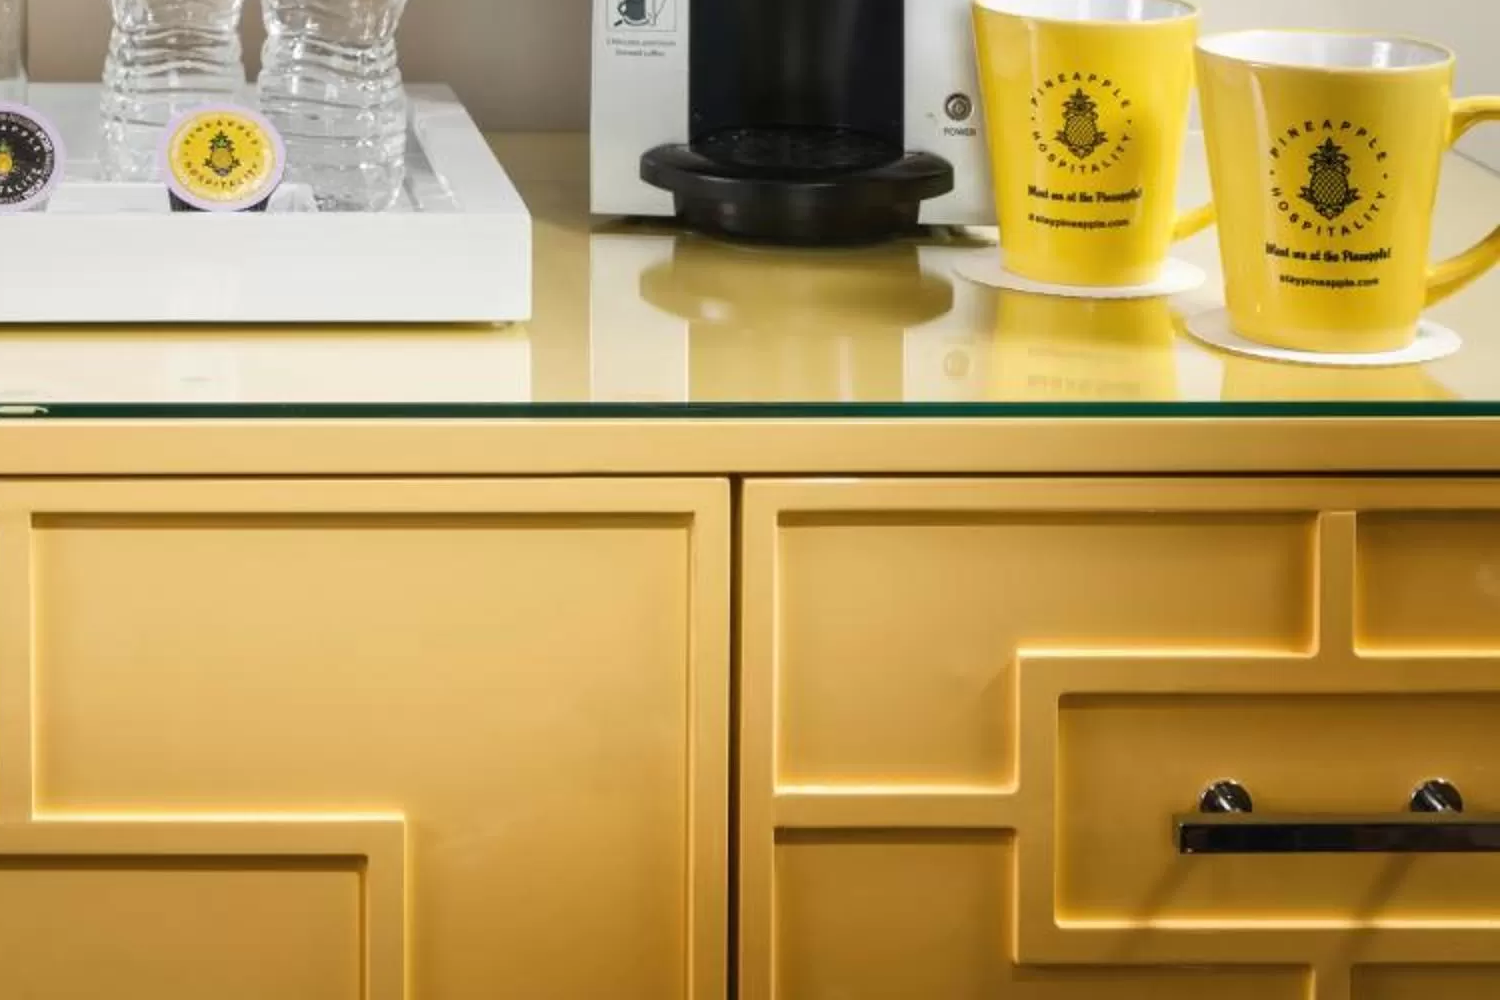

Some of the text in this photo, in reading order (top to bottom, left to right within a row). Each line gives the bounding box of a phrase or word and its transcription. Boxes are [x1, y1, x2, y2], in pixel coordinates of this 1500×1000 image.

[1030, 71, 1131, 109] PINEAPPLE
[1031, 130, 1132, 174] HOSPITALITY
[1269, 119, 1388, 163] PINEAPPLE
[1271, 186, 1386, 237] HOSPITALITY
